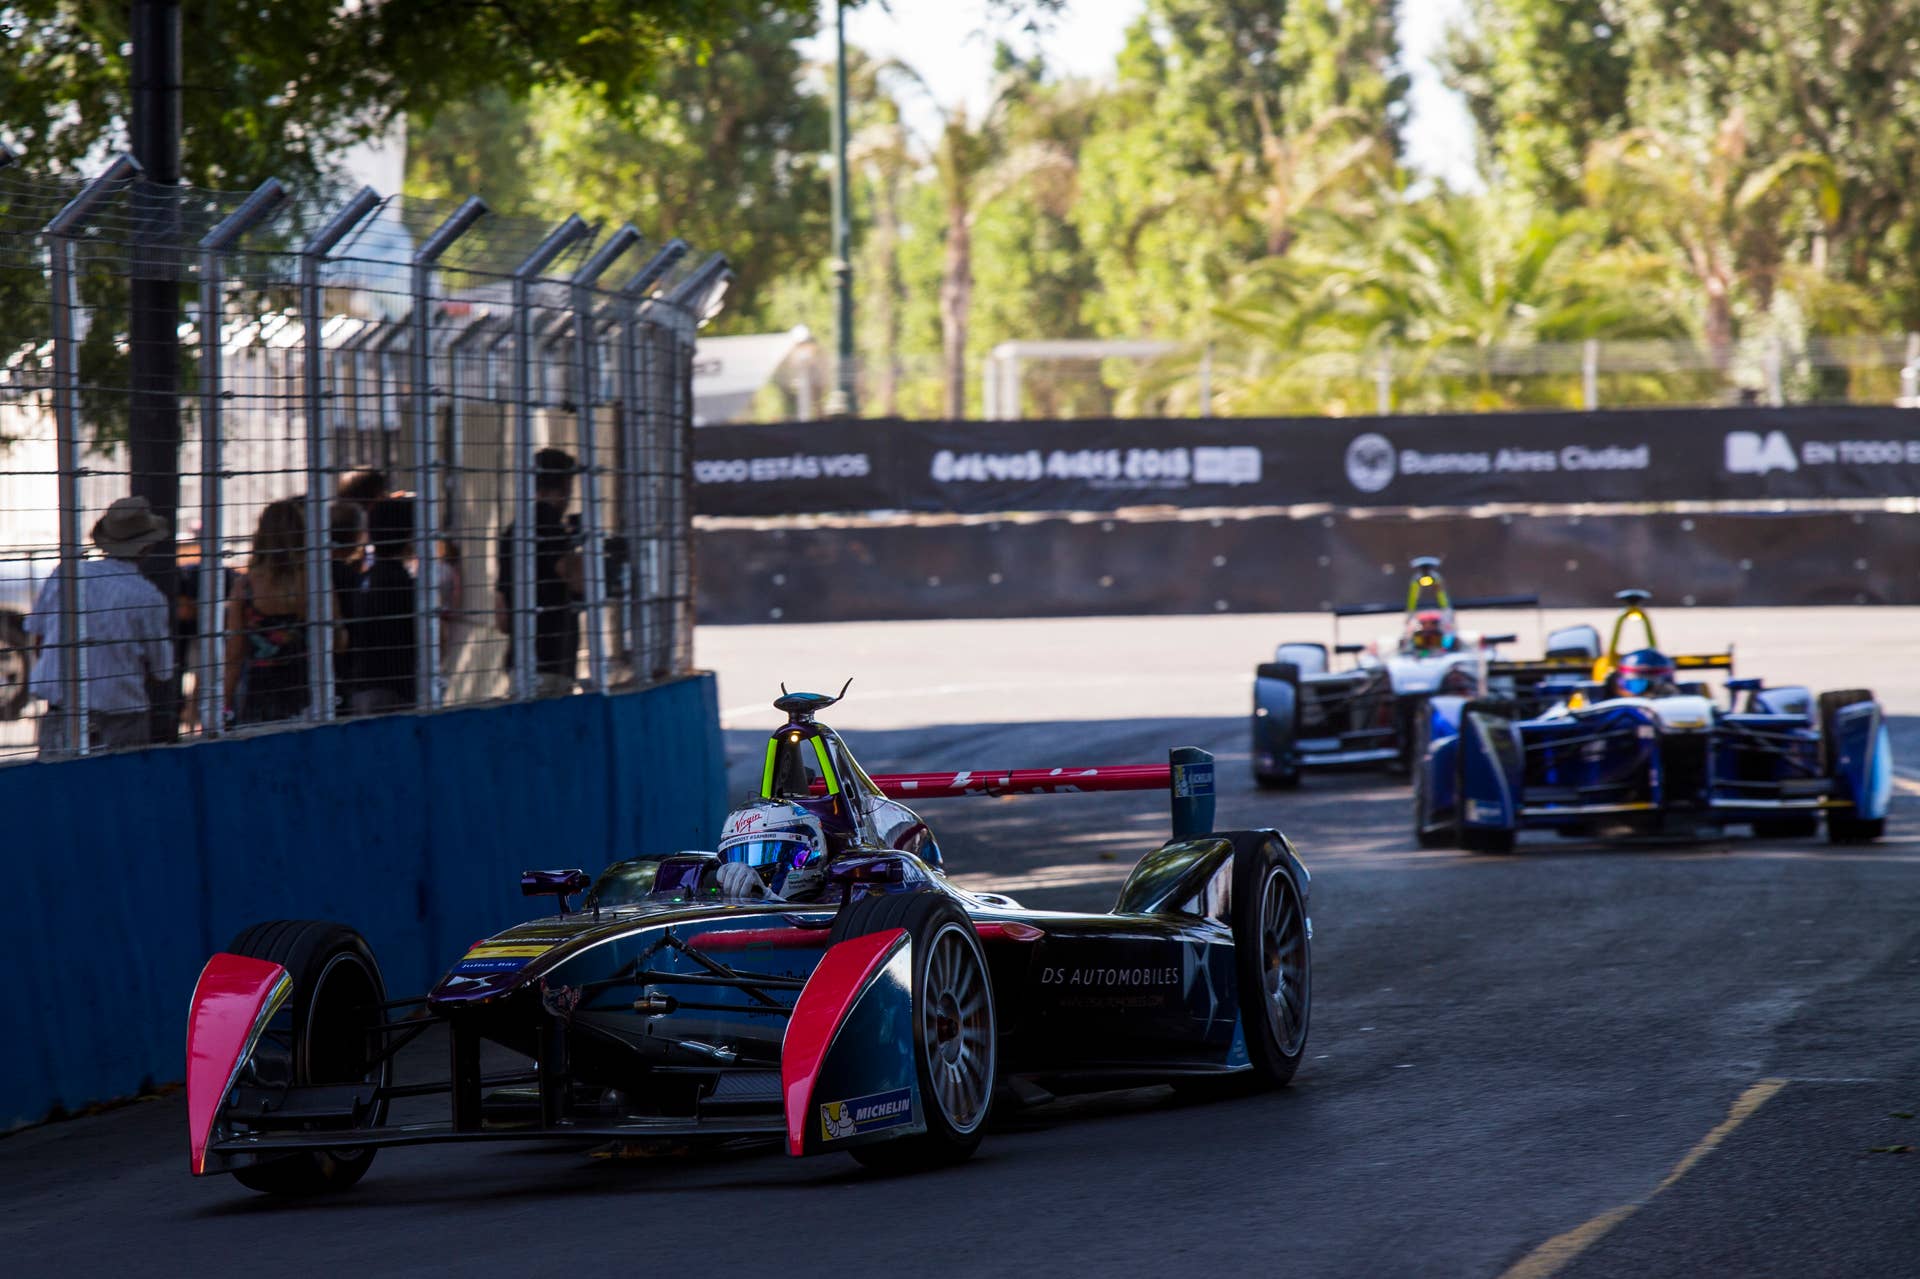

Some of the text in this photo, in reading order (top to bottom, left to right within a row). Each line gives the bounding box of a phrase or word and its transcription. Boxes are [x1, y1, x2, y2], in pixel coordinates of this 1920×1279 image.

[1401, 445, 1650, 474] Buenos Aires Ciudad
[1839, 440, 1904, 464] TODO
[822, 453, 870, 478] VOS
[734, 810, 763, 834] Virgin
[1041, 967, 1179, 985] DS AUTOMOBILES
[855, 1098, 910, 1121] MICHELIN
